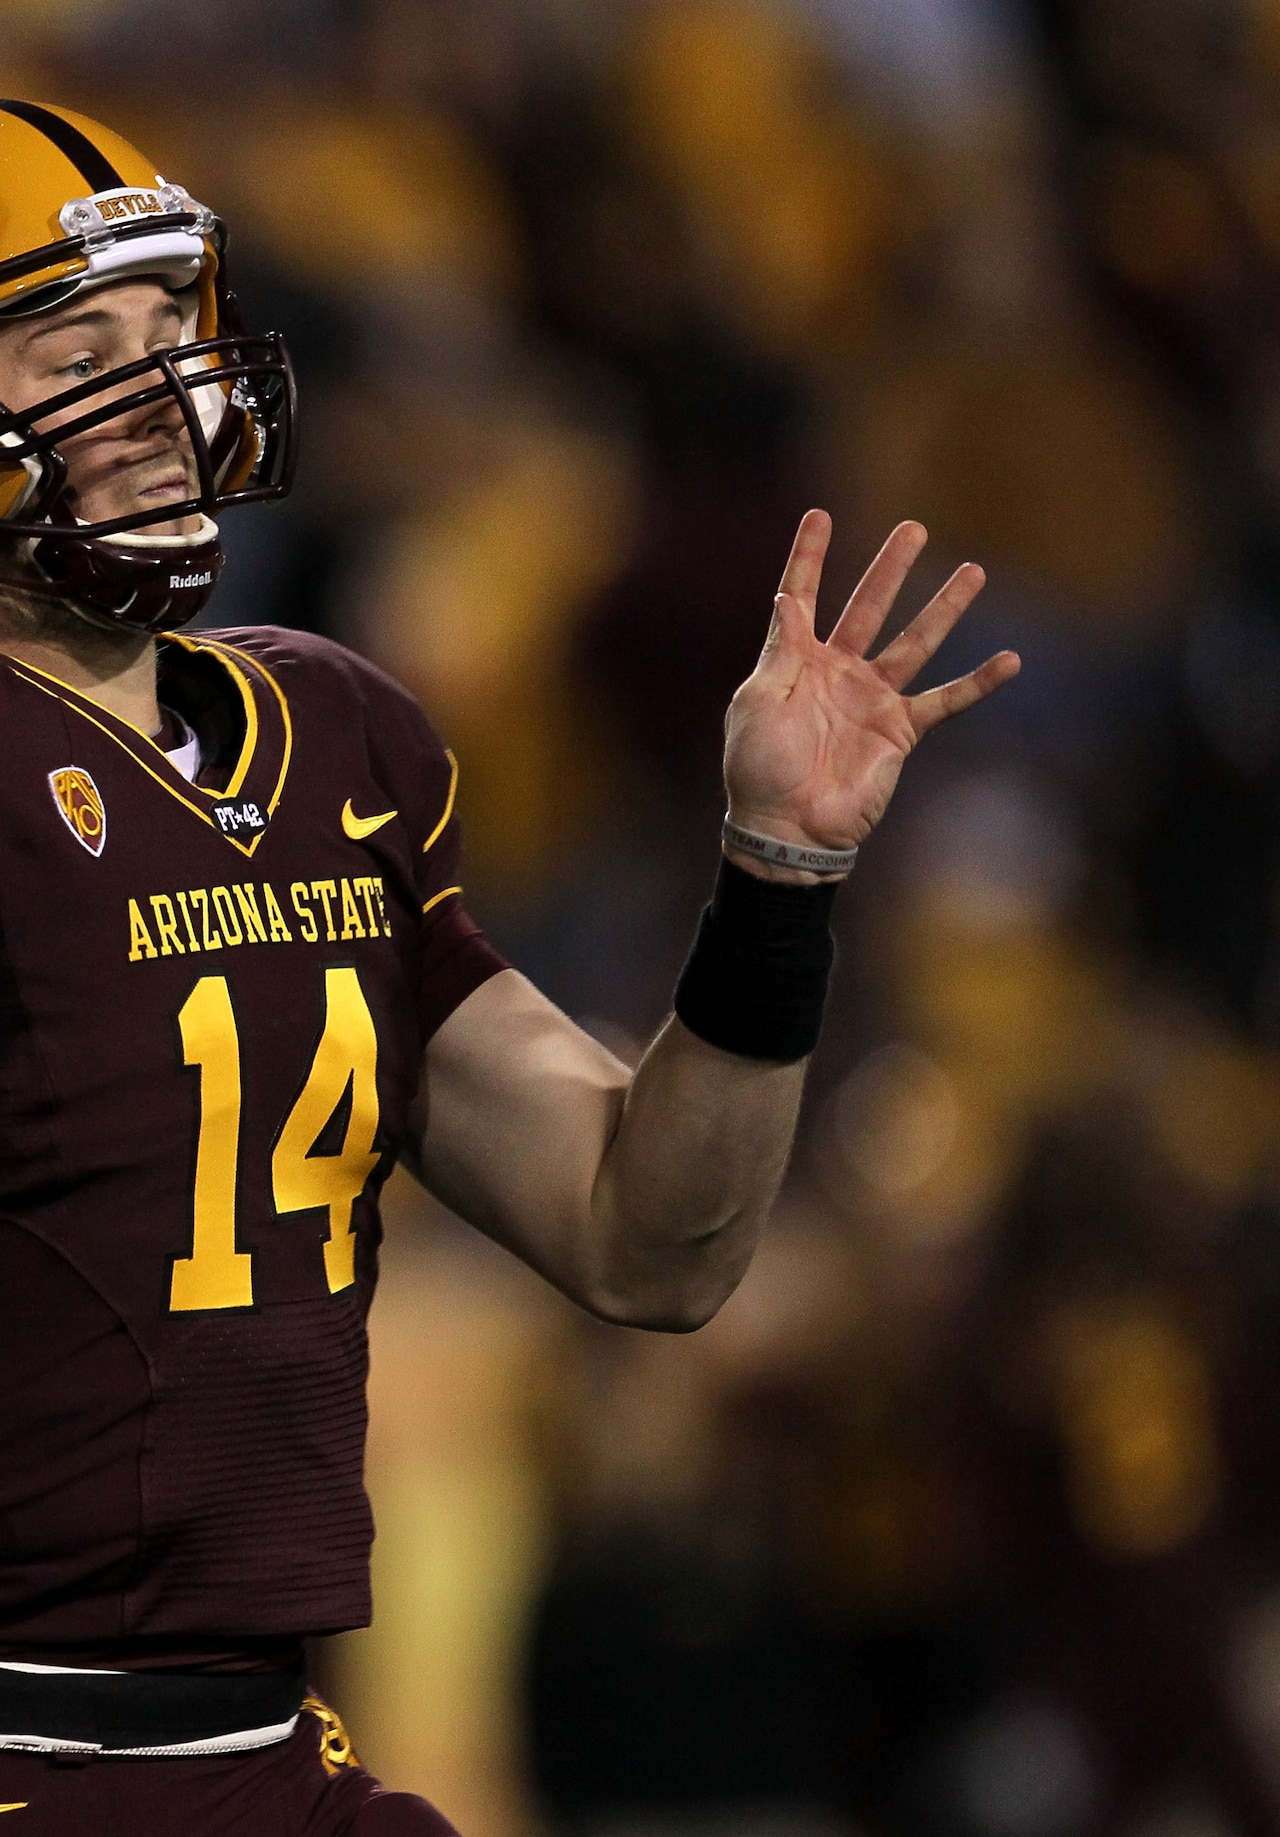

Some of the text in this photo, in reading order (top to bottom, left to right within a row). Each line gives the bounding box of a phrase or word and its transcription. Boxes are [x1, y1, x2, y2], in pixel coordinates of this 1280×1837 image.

[94, 193, 164, 221] DEVILS
[169, 571, 212, 589] Riddell
[732, 829, 853, 867] TEAM ACCOUN
[128, 877, 392, 962] ARIZONA STATE
[169, 967, 382, 1312] 14
